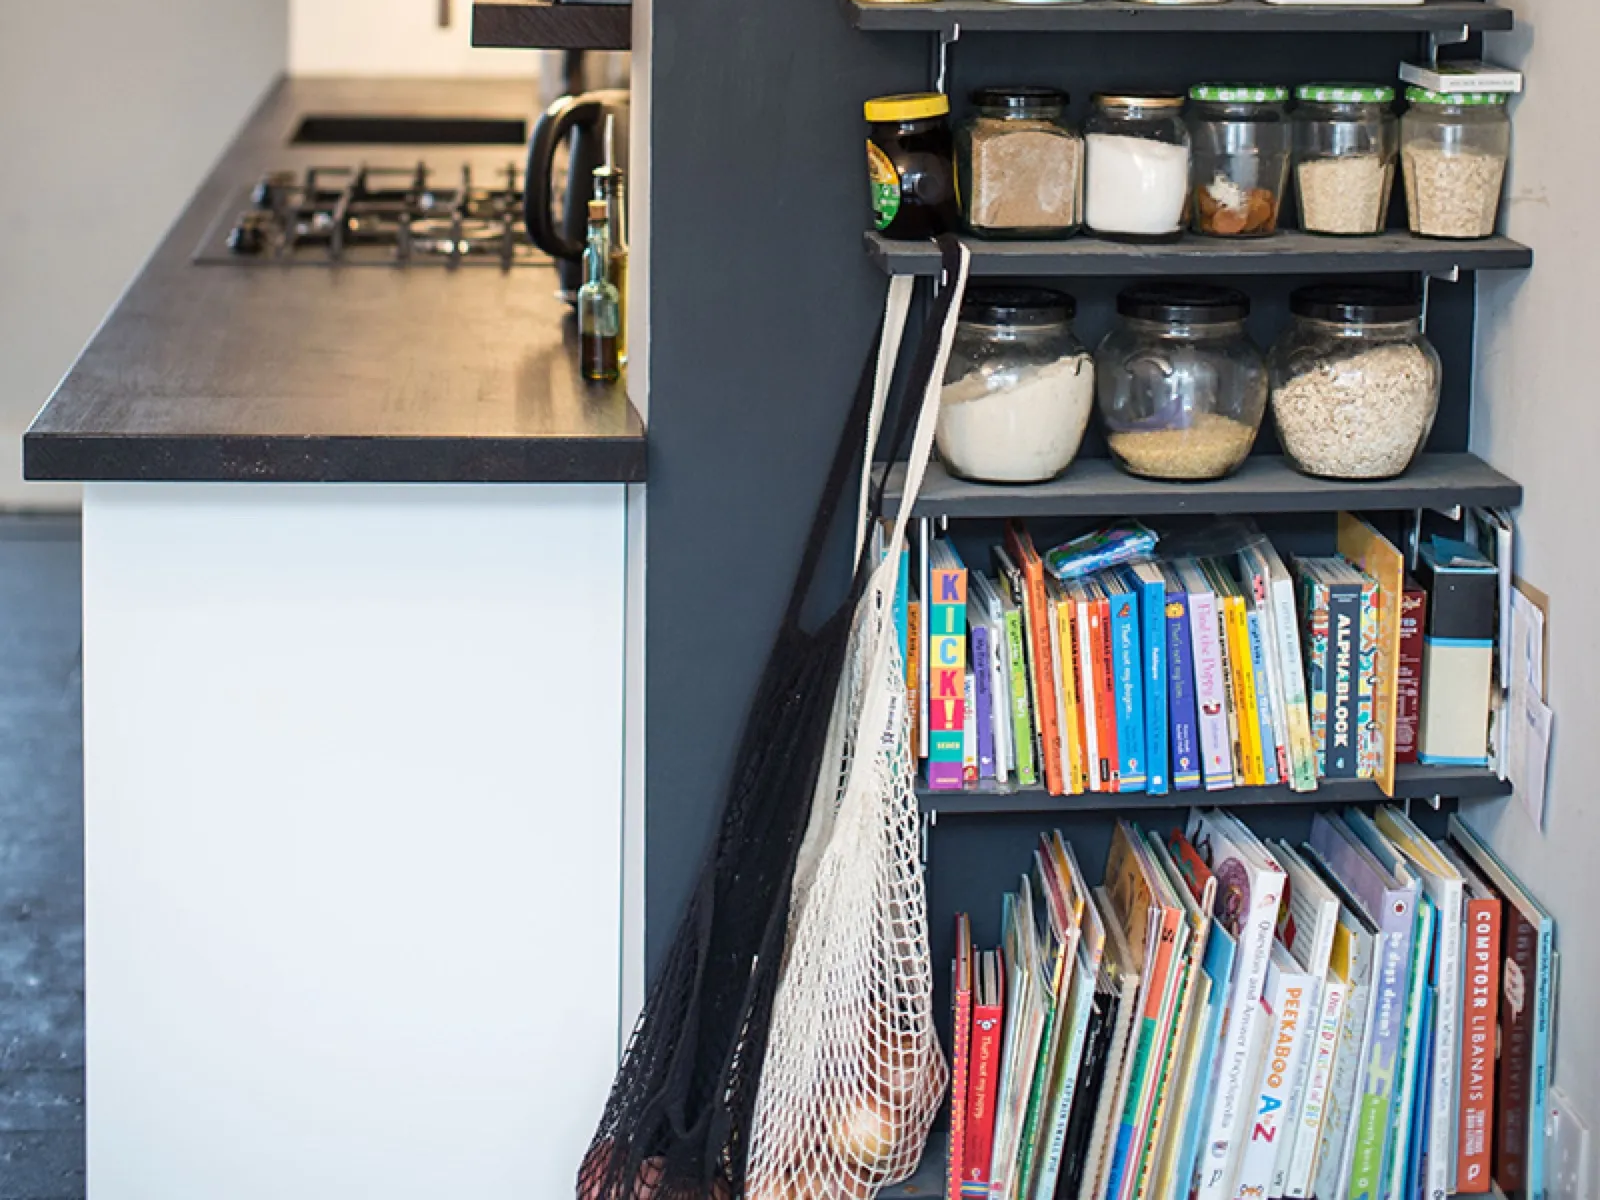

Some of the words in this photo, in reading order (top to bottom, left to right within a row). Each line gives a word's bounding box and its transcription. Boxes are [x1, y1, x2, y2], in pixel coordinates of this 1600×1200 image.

[1121, 623, 1131, 648] That's
[1198, 603, 1211, 630] Find
[939, 573, 960, 729] KICK!
[1123, 650, 1131, 665] not
[1201, 634, 1214, 654] the
[1121, 668, 1131, 683] my
[1200, 660, 1217, 699] Puppy
[1333, 613, 1352, 749] ALPHABLOCK
[1249, 919, 1270, 975] Question
[1472, 910, 1490, 1007] COMPTOIR
[1382, 951, 1400, 985] dogs
[1245, 977, 1258, 1001] and
[1236, 1004, 1254, 1047] Answer
[1377, 987, 1396, 1037] dream?
[1266, 984, 1303, 1090] PEEKABOO
[1469, 1015, 1485, 1101] LIBANAIS
[1219, 1050, 1245, 1129] Encyclopedia
[1258, 1093, 1282, 1117] A
[1251, 1122, 1276, 1144] Z
